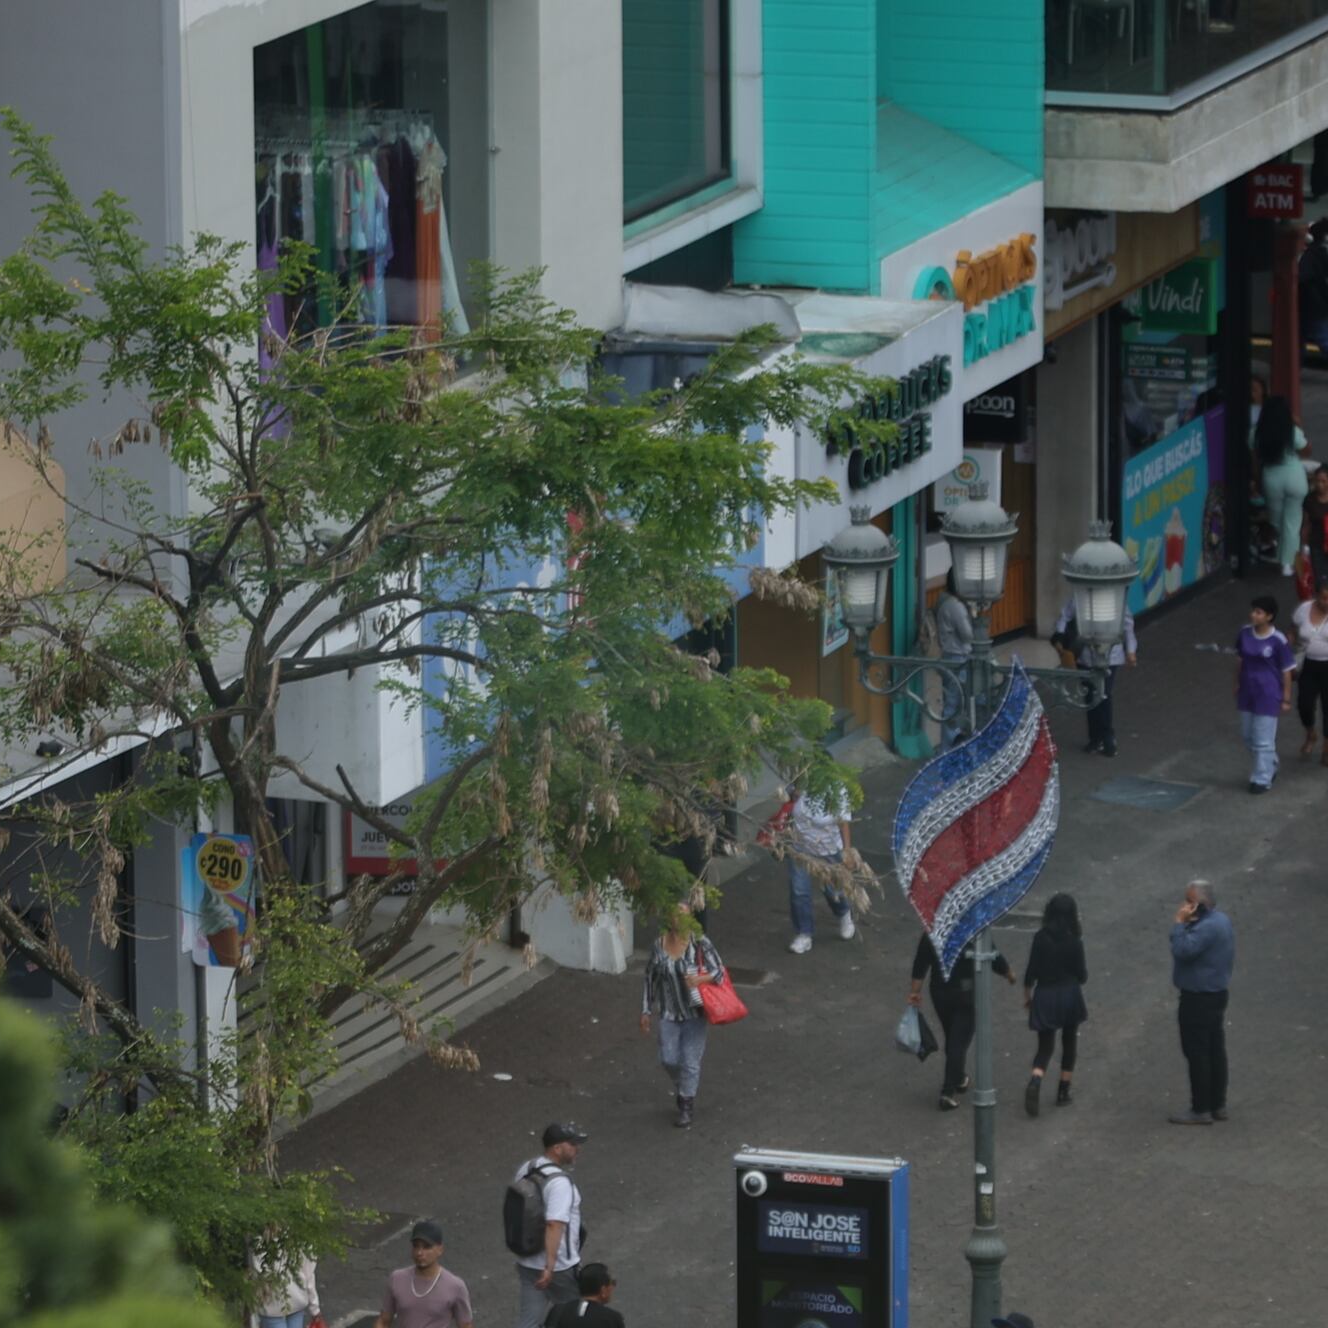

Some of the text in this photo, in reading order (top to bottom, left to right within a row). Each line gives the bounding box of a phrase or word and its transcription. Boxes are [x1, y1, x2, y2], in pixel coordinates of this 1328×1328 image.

[1254, 192, 1293, 209] ATM
[1148, 277, 1204, 313] Vindi
[964, 396, 1015, 414] poon
[848, 412, 932, 490] COFFEE
[1144, 456, 1163, 488] QUE
[1165, 430, 1202, 474] BUSCÁS
[213, 843, 235, 855] CONO
[769, 1210, 860, 1232] S@N JOSÉ
[768, 1226, 860, 1244] INTELIGENTE
[789, 1290, 836, 1303] ESPACIO
[772, 1300, 853, 1314] MONITOREADO
